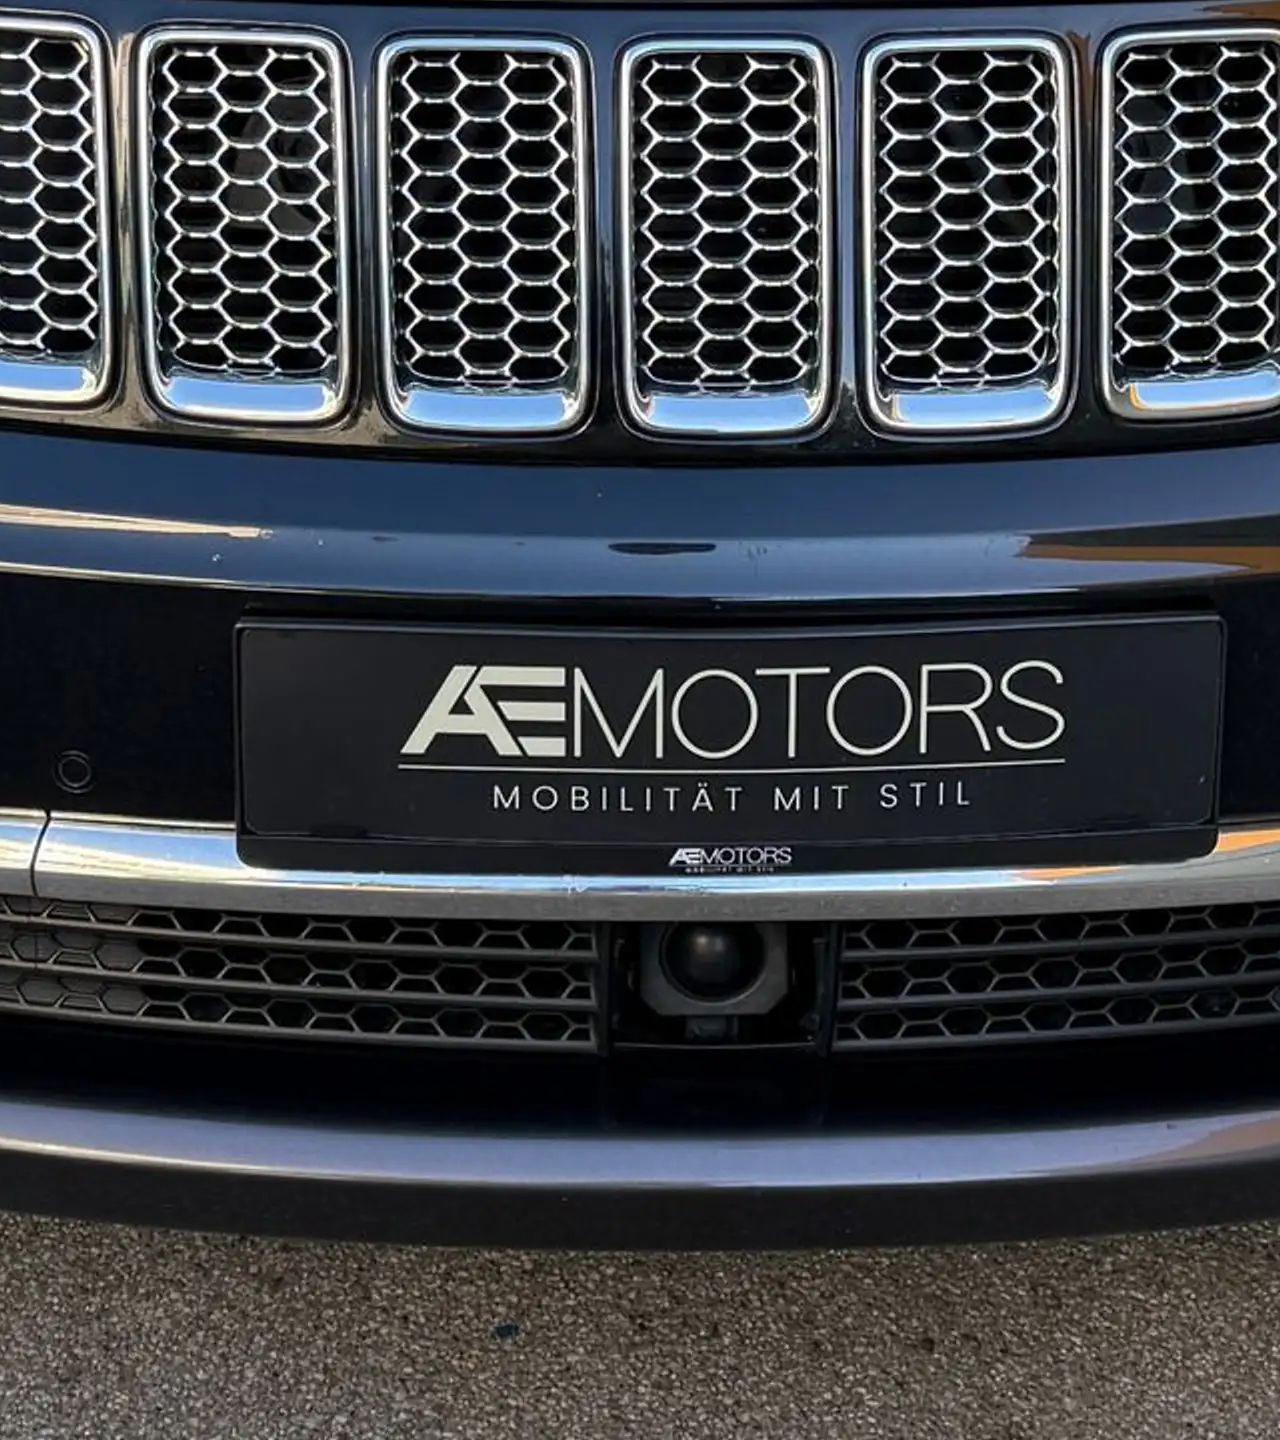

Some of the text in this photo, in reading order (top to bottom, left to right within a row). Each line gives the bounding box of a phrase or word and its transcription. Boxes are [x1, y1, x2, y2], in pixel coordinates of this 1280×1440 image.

[492, 779, 972, 813] MOBILITÄT MIT STIL
